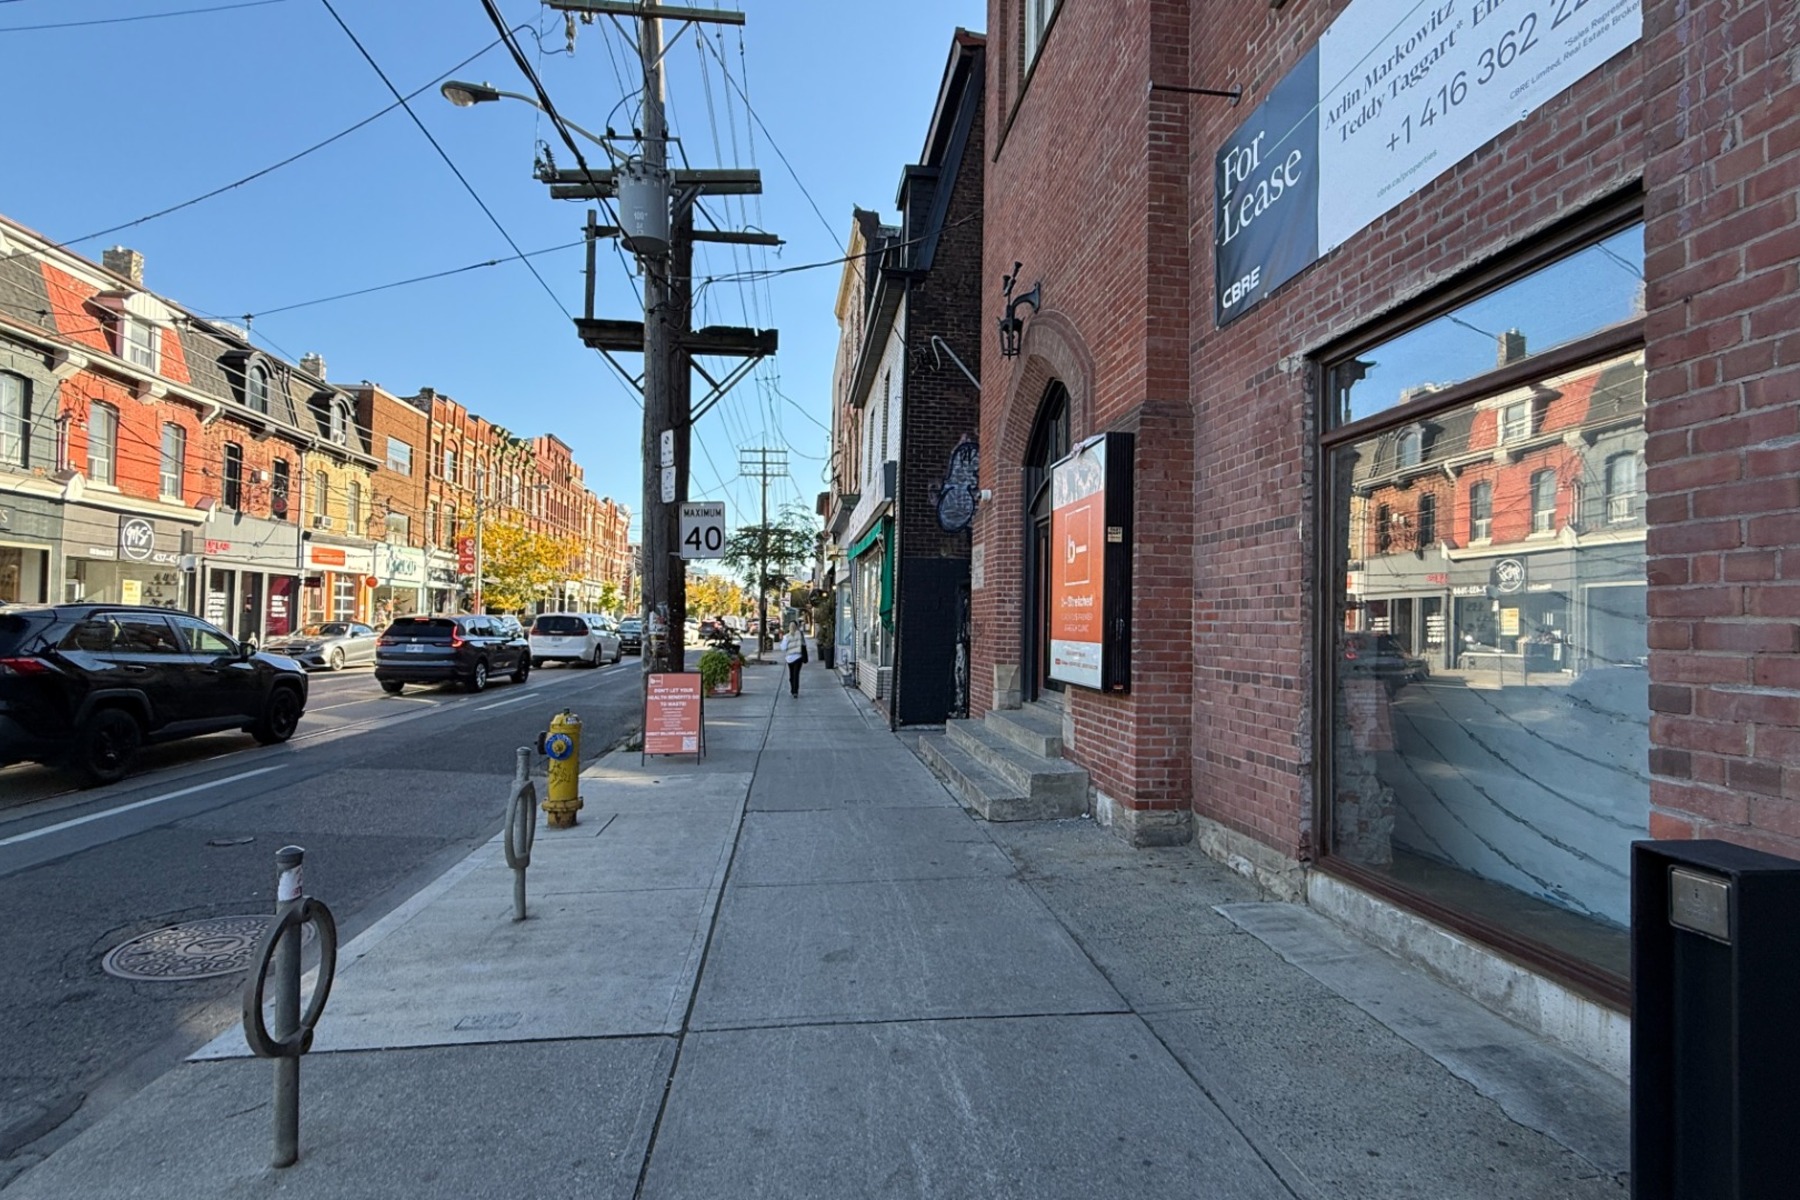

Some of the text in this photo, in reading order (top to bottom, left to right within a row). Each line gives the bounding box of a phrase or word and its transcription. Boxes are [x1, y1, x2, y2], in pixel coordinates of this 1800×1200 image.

[1325, 1, 1455, 130] Arlin Markowitz
[1386, 114, 1410, 151] +1
[1419, 70, 1468, 128] 416
[1477, 12, 1539, 86] 362
[1509, 79, 1530, 100] CBRE
[1563, 42, 1582, 62] Real
[1583, 23, 1610, 47] Estate
[1338, 93, 1386, 143] Teddy
[1222, 130, 1266, 200] For
[1222, 149, 1302, 246] Lease
[1222, 265, 1261, 309] CBRE
[683, 508, 722, 517] MAXIMUM
[684, 525, 722, 551] 40
